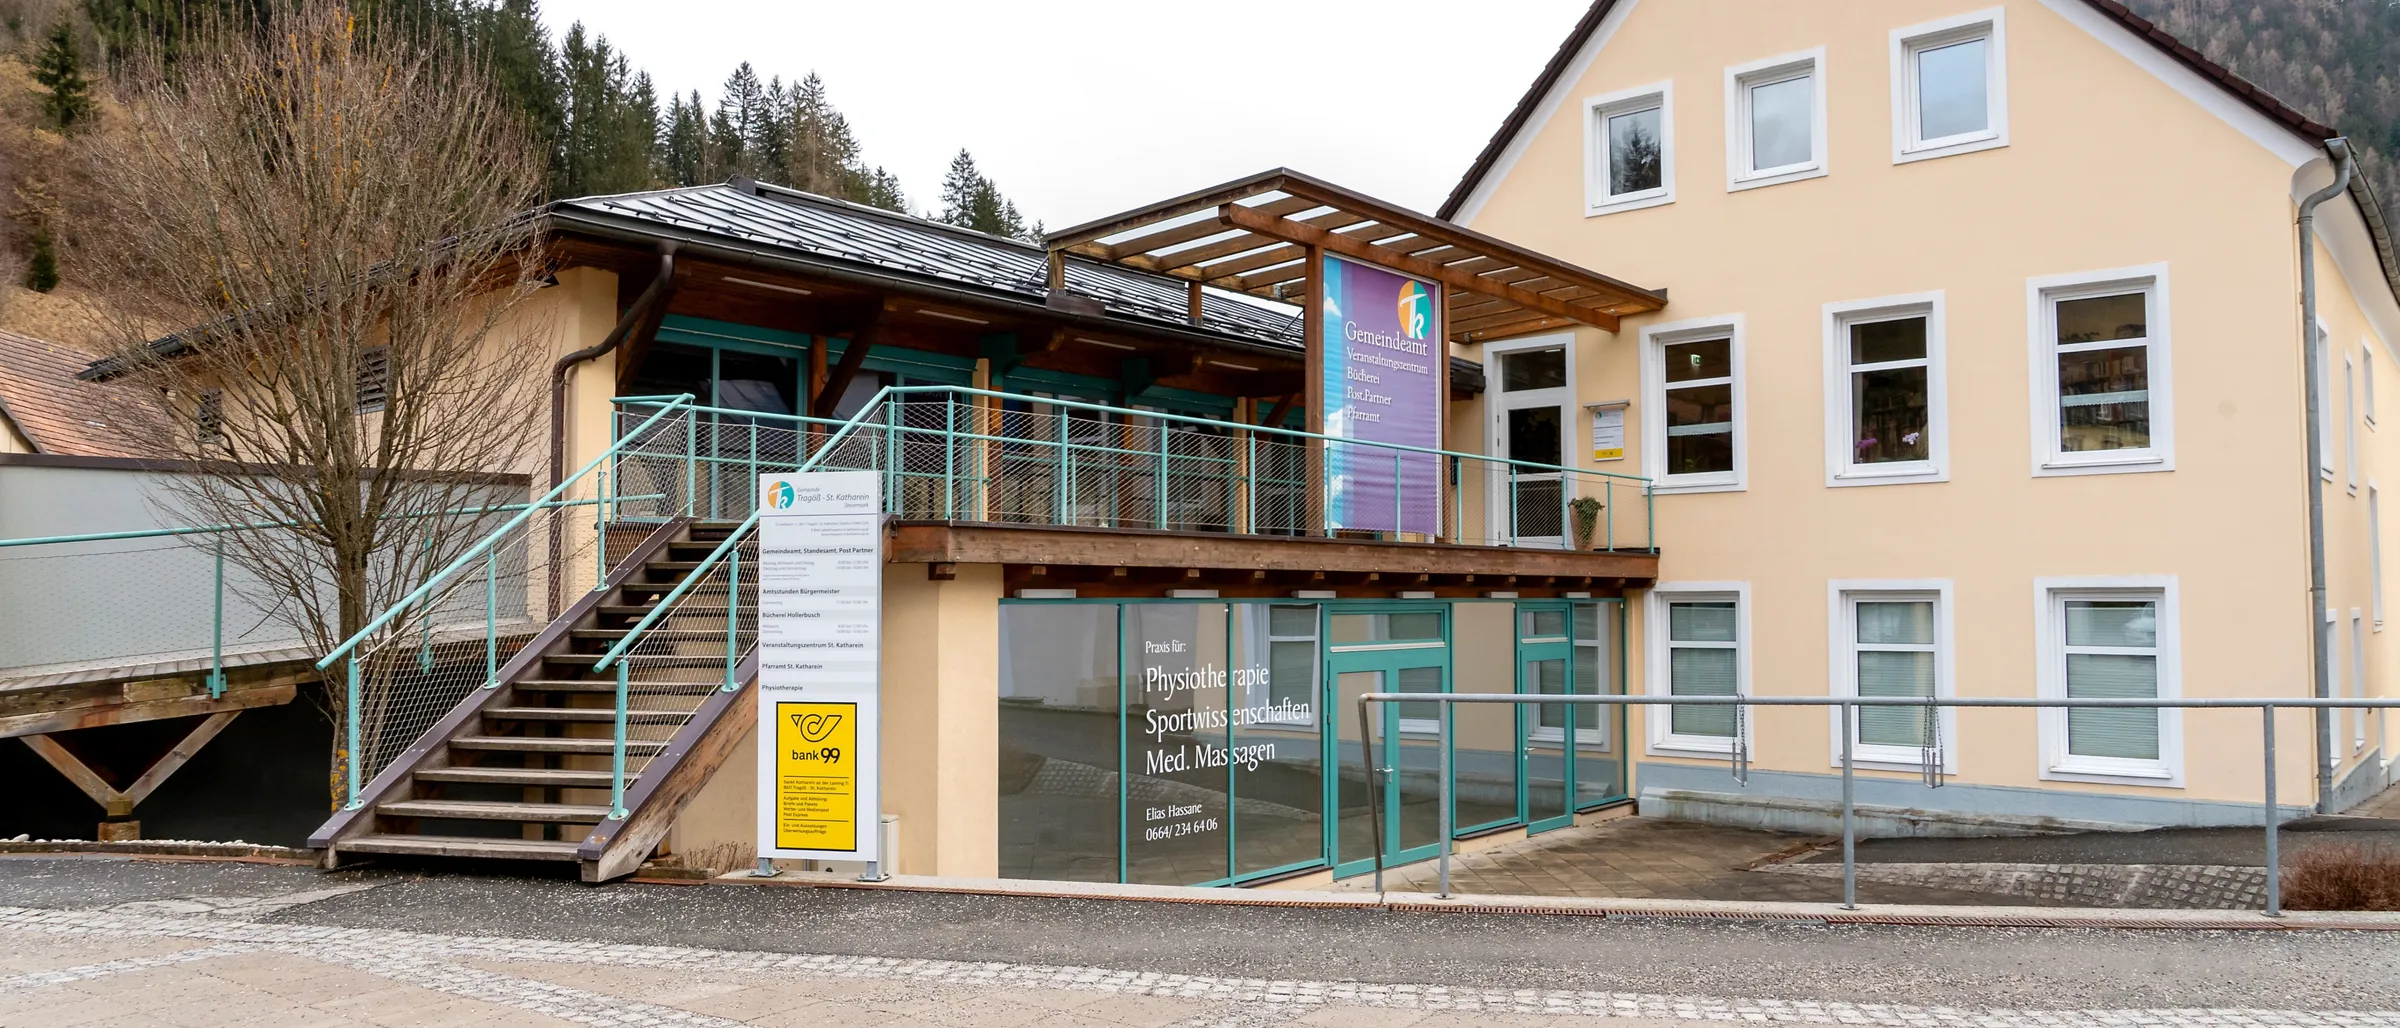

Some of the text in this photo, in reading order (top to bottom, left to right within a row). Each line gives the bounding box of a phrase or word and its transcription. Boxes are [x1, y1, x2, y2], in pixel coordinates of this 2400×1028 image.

[1345, 321, 1428, 356] Gemeindeamt
[1347, 347, 1428, 375] Veranstaltungszentrum
[1347, 367, 1380, 385] Bücherei
[1347, 386, 1392, 406] Post.Partner
[1347, 404, 1380, 423] Pfarramt
[797, 494, 821, 503] Tragöß
[836, 493, 870, 501] Katharein
[1145, 639, 1186, 654] Praxis für:
[761, 684, 803, 692] Physiotherapie
[792, 747, 840, 764] bank 99
[1146, 744, 1190, 775] Med.
[1146, 803, 1202, 821] Elias Hassane
[1146, 826, 1173, 842] 0664/
[1174, 823, 1191, 837] 234
